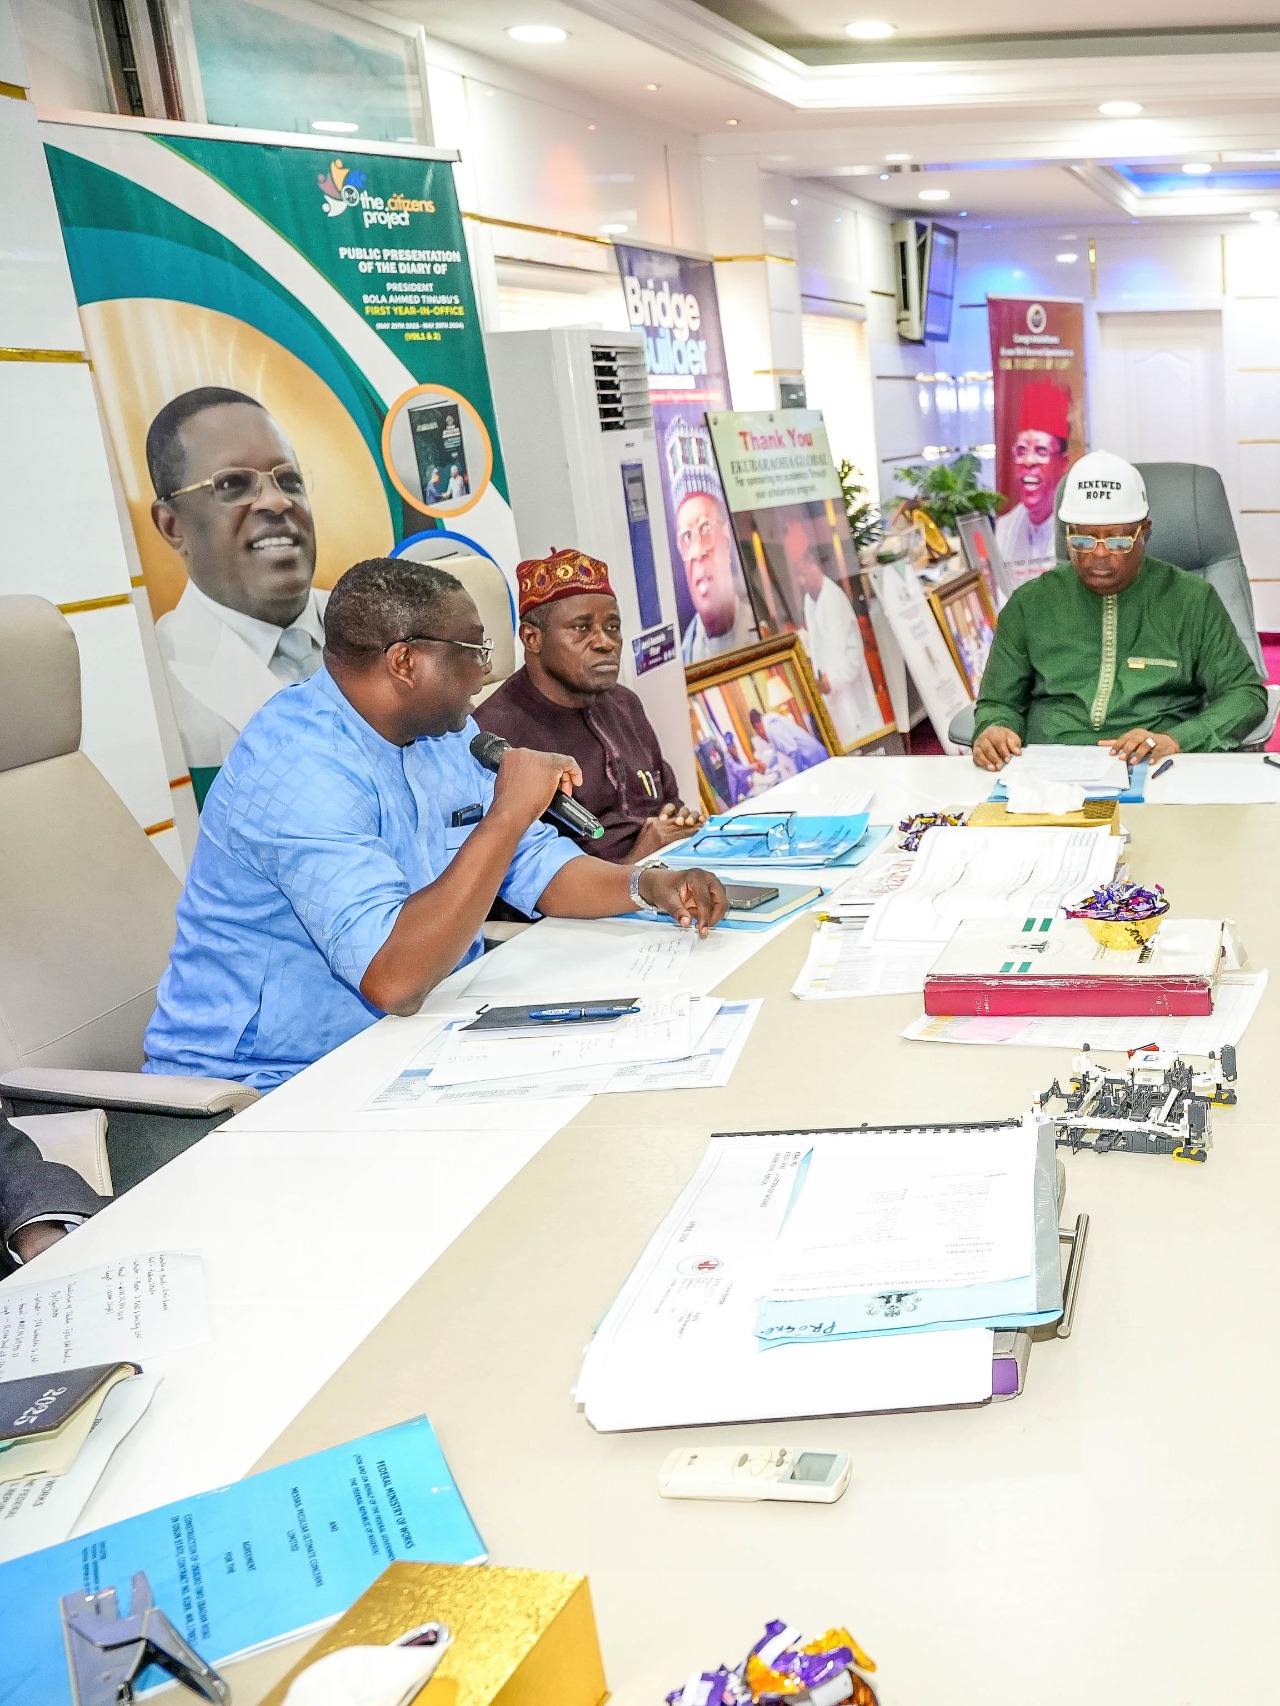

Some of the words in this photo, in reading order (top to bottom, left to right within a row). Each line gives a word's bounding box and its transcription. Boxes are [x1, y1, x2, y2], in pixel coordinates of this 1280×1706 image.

[359, 190, 384, 210] the
[387, 193, 436, 213] citizens
[363, 207, 411, 229] project
[339, 247, 381, 260] PUBLIC
[382, 249, 461, 262] PRESENTATION
[358, 261, 374, 273] OF
[375, 262, 397, 273] THE
[398, 263, 431, 274] DIARY
[433, 264, 448, 274] OF
[386, 282, 434, 292] PRESIDENT
[362, 294, 387, 304] BOLA
[388, 294, 420, 304] AHMED
[421, 295, 460, 305] TINUBU'S
[365, 306, 391, 315] FIRST
[392, 306, 464, 315] YEAR-IN-OFFICE
[624, 276, 700, 341] Bridge
[738, 429, 786, 452] Thank
[786, 427, 814, 448] You
[1078, 480, 1122, 490] RENEWED
[1086, 491, 1112, 500] HOPE
[760, 1321, 836, 1336] PROGRE
[13, 1387, 68, 1426] 2025
[376, 1460, 393, 1488] FEDERAL
[4, 1488, 31, 1520] FEDERAL
[32, 1480, 56, 1508] WORKS
[386, 1487, 404, 1517] MINISTRY
[396, 1517, 407, 1526] OF
[382, 1533, 396, 1561] GOVERNMEN
[400, 1526, 415, 1549] WORKS
[243, 1541, 257, 1571] AGREEMENT
